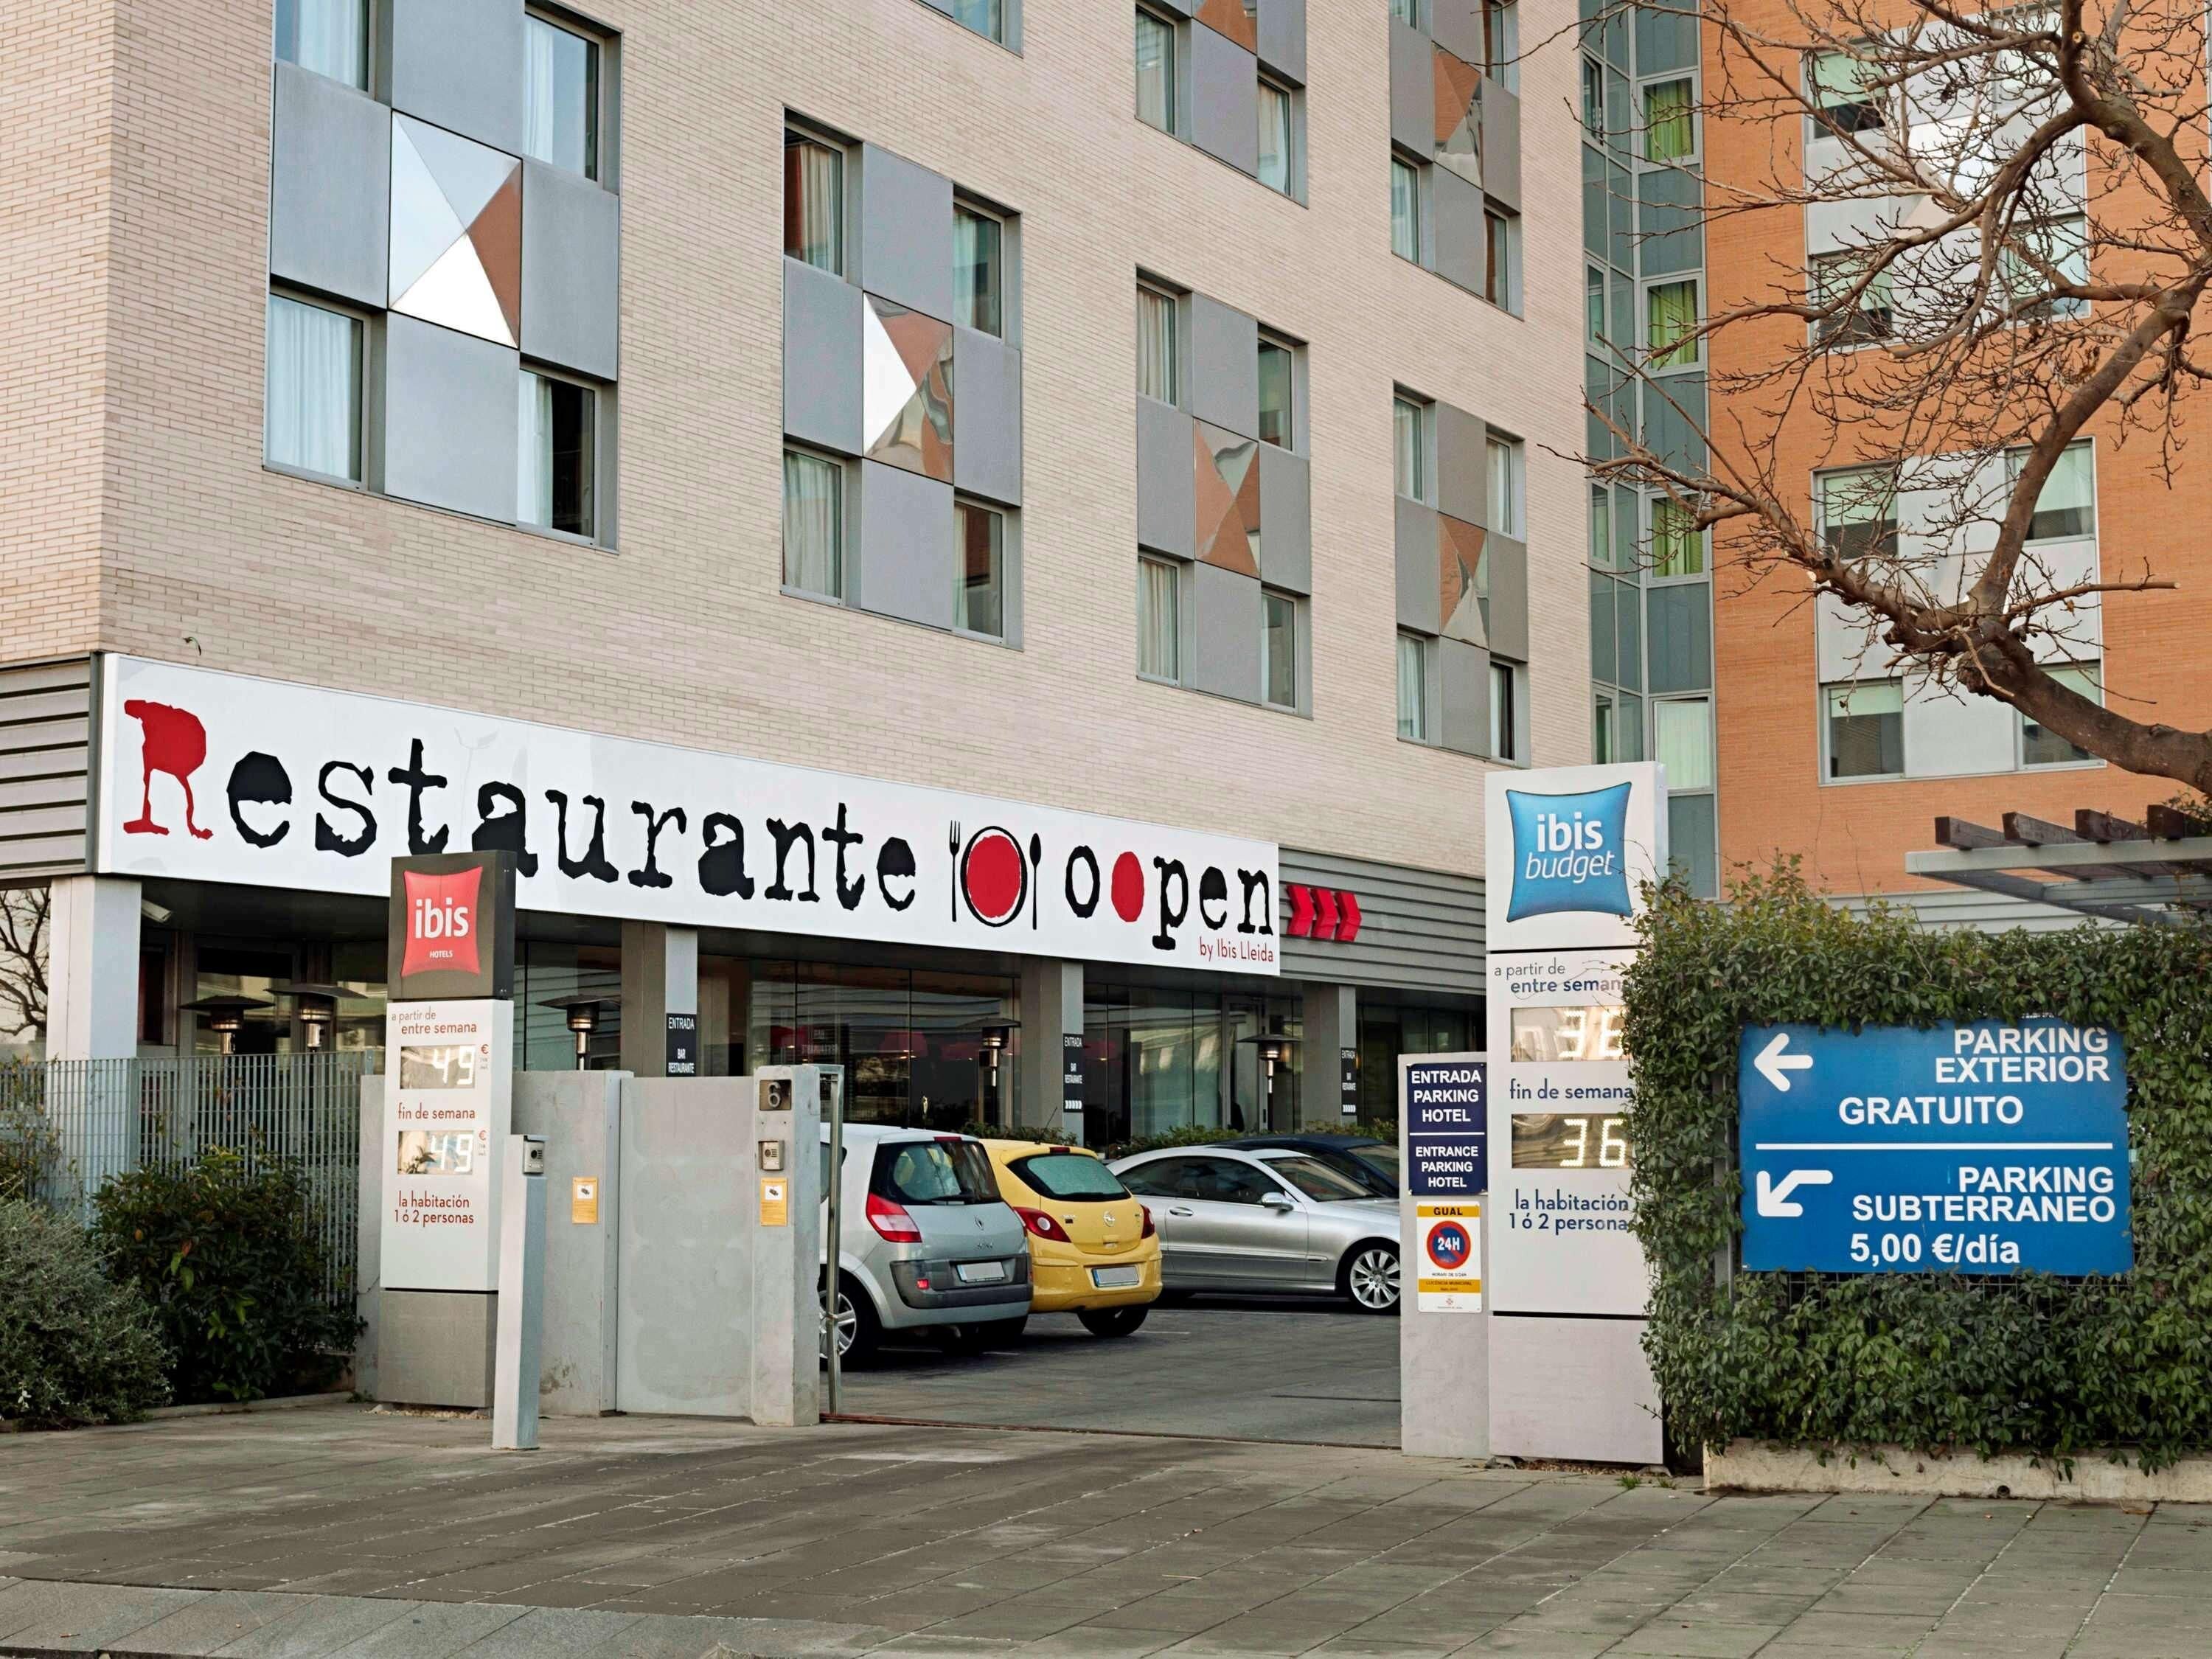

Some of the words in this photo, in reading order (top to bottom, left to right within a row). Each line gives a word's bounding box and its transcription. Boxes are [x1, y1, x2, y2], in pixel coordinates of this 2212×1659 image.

[123, 699, 917, 911] Restaurante
[1537, 812, 1603, 852] ibis
[1526, 850, 1614, 883] budget
[415, 897, 469, 939] ibis
[430, 950, 453, 959] HOTELS
[1200, 936, 1213, 961] by
[1217, 938, 1237, 959] Ibis
[1240, 941, 1274, 962] Lleida
[1494, 966, 1502, 976] a
[1506, 962, 1545, 980] partir
[1548, 958, 1565, 975] de
[1511, 978, 1557, 993] entre
[1563, 979, 1622, 992] seman
[392, 1012, 397, 1021] a
[399, 1010, 424, 1023] partir
[425, 1006, 437, 1020] de
[668, 1018, 695, 1029] ENTRADA
[401, 1023, 431, 1034] entre
[434, 1023, 477, 1033] semana
[1955, 1027, 2109, 1054] PARKING
[678, 1048, 686, 1060] BAR
[431, 1045, 476, 1085] 49
[1935, 1056, 2111, 1084] EXTERIOR
[1411, 1070, 1481, 1084] ENTRADA
[768, 1082, 782, 1107] 6
[1413, 1089, 1479, 1103] PARKING
[1510, 1079, 1531, 1099] fin
[1537, 1079, 1560, 1099] de
[1565, 1085, 1633, 1099] semana
[398, 1102, 411, 1119] fin
[415, 1103, 429, 1119] de
[432, 1109, 476, 1119] semana
[1422, 1108, 1471, 1122] HOTEL
[1839, 1096, 2023, 1125] GRATUITO
[431, 1133, 473, 1173] 49
[1416, 1146, 1478, 1158] ENTRANCE
[1560, 1119, 1627, 1168] 36
[1422, 1161, 1473, 1172] PARKING
[1428, 1177, 1467, 1188] HOTEL
[1958, 1166, 2114, 1193] PARKING
[399, 1191, 408, 1208] la
[411, 1191, 470, 1208] habitación
[1516, 1189, 1530, 1210] la
[1536, 1189, 1629, 1211] habitación
[1852, 1194, 2115, 1222] SUBTERRANEO
[395, 1209, 399, 1222] 1
[403, 1208, 409, 1222] ó
[413, 1209, 420, 1222] 2
[423, 1213, 474, 1227] personas
[1433, 1207, 1463, 1216] GUAL
[1509, 1214, 1515, 1228] 1
[1522, 1213, 1532, 1229] ó
[1538, 1214, 1549, 1229] 2
[1555, 1219, 1628, 1235] persona
[1438, 1237, 1460, 1251] 24H
[1850, 1233, 1921, 1267] 5,00
[1931, 1233, 2020, 1265] €/día
